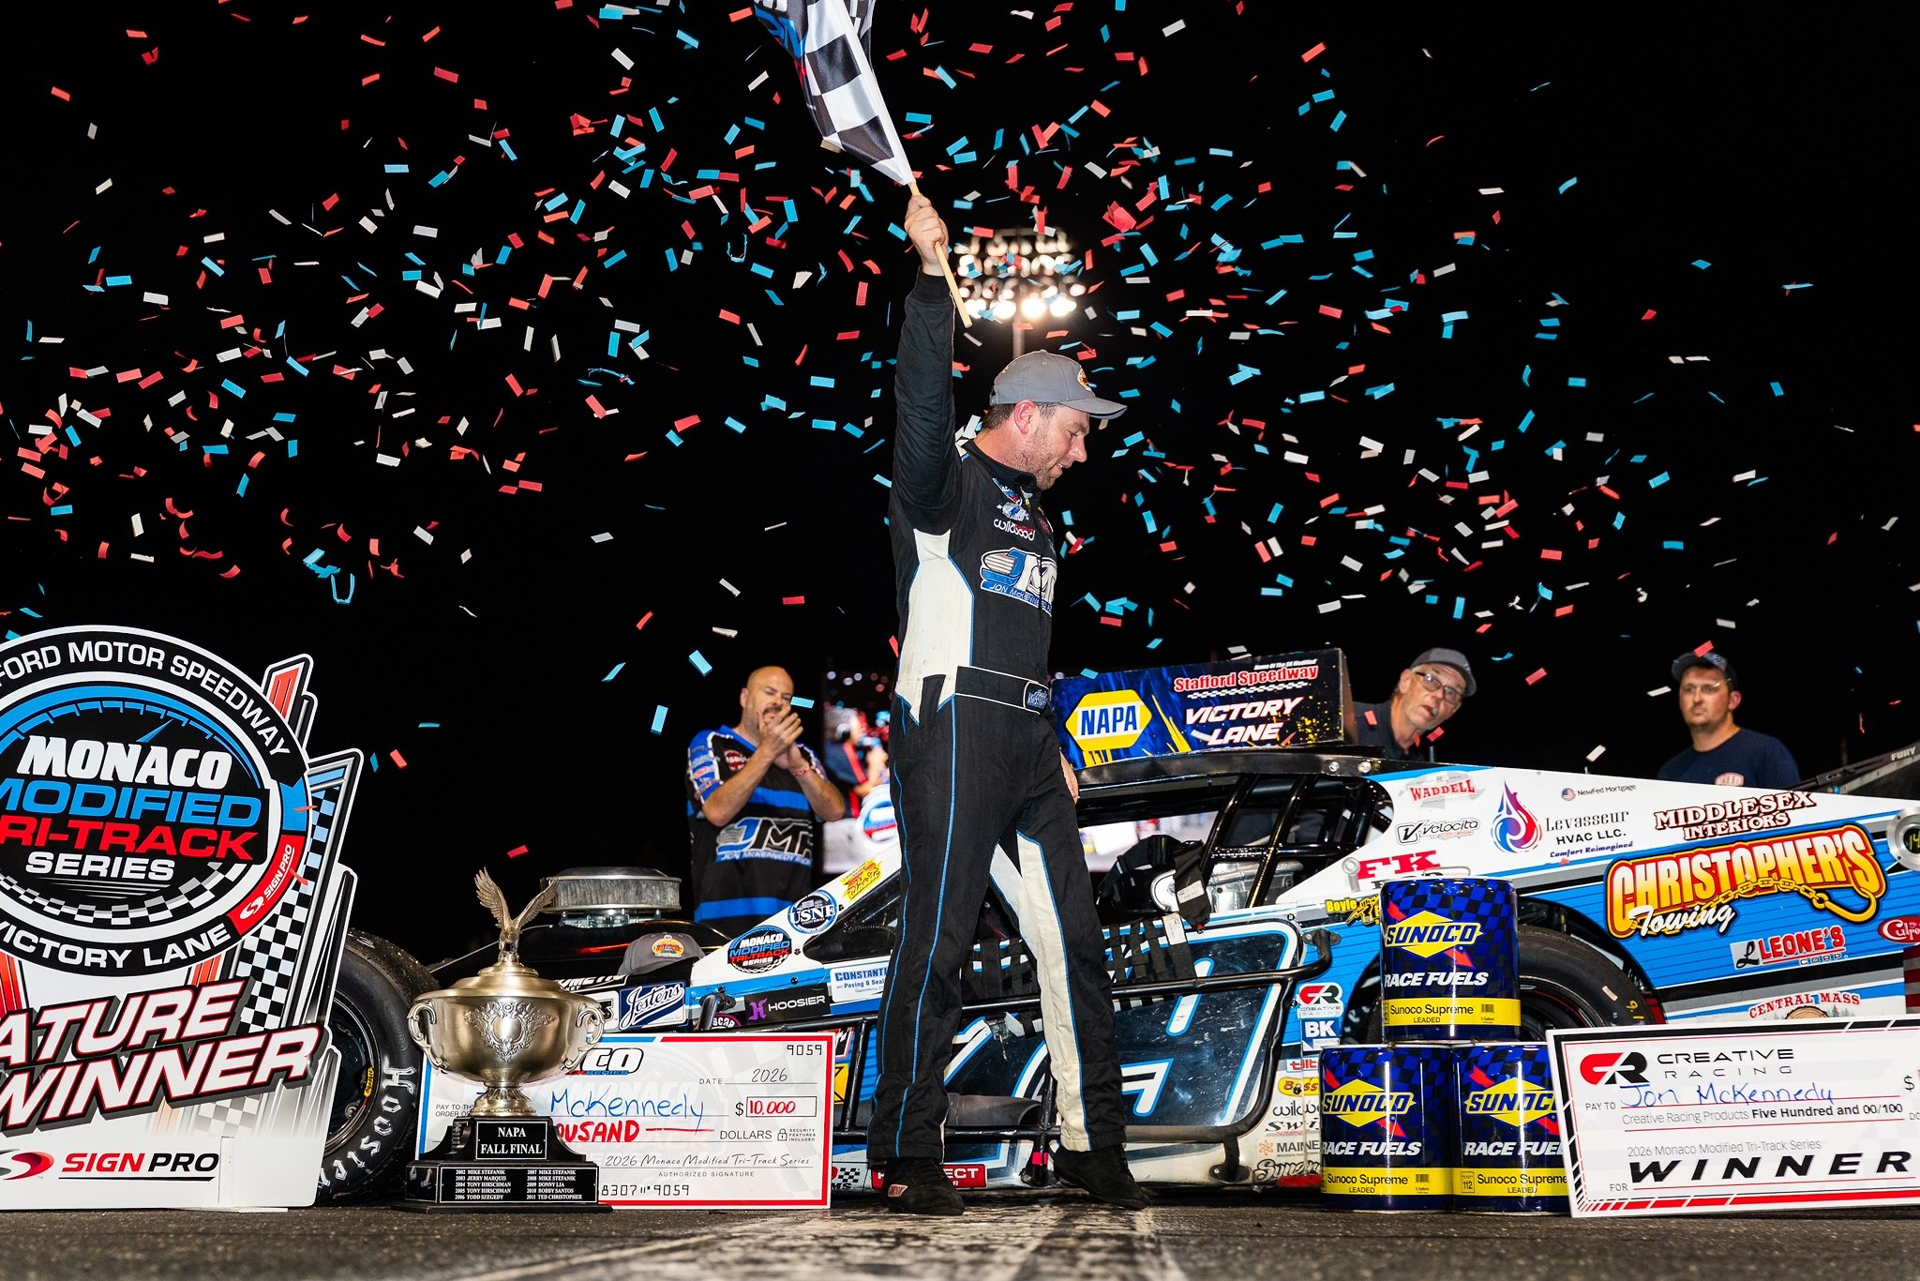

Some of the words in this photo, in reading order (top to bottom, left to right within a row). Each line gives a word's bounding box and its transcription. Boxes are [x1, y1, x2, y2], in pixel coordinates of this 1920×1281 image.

[989, 583, 1008, 593] JON
[1173, 672, 1237, 693] Stafford
[1237, 664, 1319, 687] Speedway
[0, 644, 61, 687] ORD
[68, 640, 165, 669] MOTOR
[170, 654, 291, 757] SPEEDWAY
[1185, 696, 1304, 726] VICTORY
[1080, 704, 1138, 736] NAPA
[1206, 721, 1285, 746] LANE
[16, 735, 232, 790] MONACO
[1410, 779, 1476, 801] WADDELL
[1605, 783, 1637, 793] Mortgage
[1652, 790, 1818, 830] MIDDLESEX
[1545, 811, 1630, 832] Levasseur
[1682, 812, 1791, 841] INTERIORS
[1556, 832, 1593, 845] HVAC
[1597, 828, 1627, 840] LLC.
[1550, 849, 1583, 857] Comfort
[1585, 841, 1634, 853] Reimagined
[25, 851, 175, 881] SERIES
[263, 870, 284, 898] SIGN
[279, 844, 293, 872] PRO
[1357, 850, 1441, 880] FK
[1610, 829, 1882, 933] CHRISTOPHER'S
[1326, 899, 1358, 912] Boyle
[1627, 903, 1736, 937] Towing
[739, 933, 784, 948] MONACO
[1385, 923, 1480, 945] SUNOCO
[1760, 925, 1846, 960] LEONE'S
[143, 922, 232, 967] LANE
[729, 940, 790, 957] MODIFIED
[731, 949, 790, 965] TRI-TRACK
[742, 957, 774, 966] SERIES
[1384, 972, 1424, 988] RACE
[1425, 971, 1489, 988] FUELS
[620, 983, 685, 1030] Jostens
[768, 994, 826, 1012] HOOSIER
[1390, 1004, 1422, 1015] Sunoco
[1424, 1003, 1474, 1016] Supreme
[1749, 993, 1814, 1020] CENTRAL
[1819, 992, 1861, 1006] MASS
[1304, 1020, 1337, 1038] BK
[786, 1044, 822, 1056] 9059
[1656, 1048, 1795, 1064] CREATIVE
[0, 1026, 322, 1127] WINNER
[751, 1068, 788, 1083] 2026
[1664, 1065, 1793, 1079] RACING
[1904, 1075, 1915, 1092] $
[1322, 1093, 1411, 1113] SUNOCO
[1620, 1083, 1679, 1108] Jon
[1699, 1081, 1835, 1106] McKennedy
[550, 1085, 704, 1136] McKennedy
[735, 1102, 744, 1116] $
[1585, 1102, 1603, 1111] PAY
[1604, 1101, 1617, 1111] TO
[1622, 1112, 1666, 1125] Creative
[1667, 1111, 1702, 1125] Racing
[1703, 1109, 1750, 1122] Products
[1752, 1107, 1777, 1119] Five
[1780, 1105, 1833, 1118] Hundred
[1837, 1104, 1860, 1116] and
[1862, 1103, 1903, 1116] 00/100
[497, 1126, 526, 1138] NAPA
[720, 1130, 772, 1140] DOLLARS
[480, 1143, 508, 1155] FALL
[509, 1143, 543, 1155] FINAL
[1322, 1141, 1356, 1156] RACE
[1358, 1141, 1422, 1156] FUELS
[1464, 1141, 1513, 1156] RACE
[1627, 1146, 1652, 1157] 2026
[1655, 1145, 1698, 1156] Monaco
[1699, 1142, 1743, 1154] Modified
[1745, 1140, 1787, 1152] Tri-Track
[1790, 1138, 1822, 1150] Series
[62, 1152, 145, 1172] SIGN
[148, 1152, 220, 1172] PRO
[605, 1154, 638, 1167] 2026
[640, 1154, 681, 1167] Monaco
[682, 1154, 730, 1167] Modified
[732, 1153, 778, 1165] Tri-Track
[780, 1154, 810, 1167] Series
[1629, 1150, 1912, 1184] WINNER
[1327, 1173, 1357, 1184] Sunoco
[1359, 1173, 1408, 1186] Supreme
[1463, 1182, 1473, 1190] 112
[1477, 1173, 1517, 1184] Sunoco
[1520, 1173, 1567, 1186] Supreme
[1609, 1183, 1628, 1192] FOR
[1349, 1186, 1375, 1194] LEADED
[1507, 1186, 1538, 1194] LEADED
